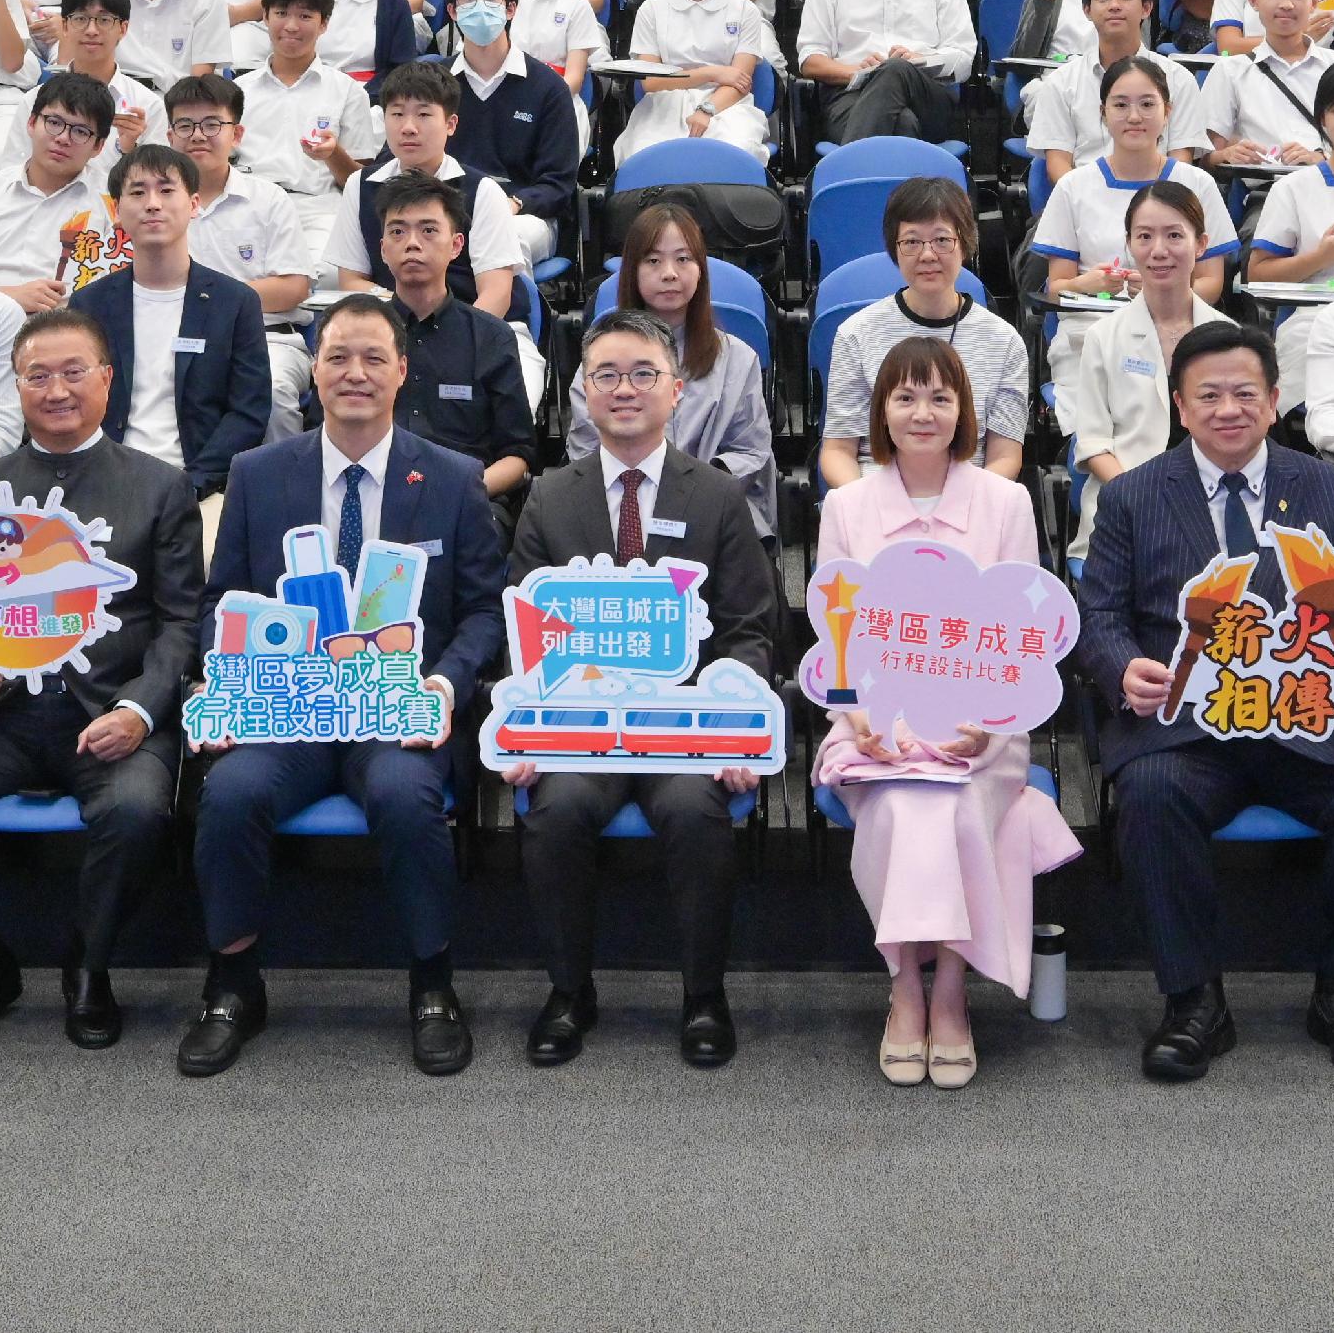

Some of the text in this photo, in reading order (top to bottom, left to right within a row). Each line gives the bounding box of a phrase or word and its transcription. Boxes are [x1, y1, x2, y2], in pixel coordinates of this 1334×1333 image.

[72, 228, 134, 263] 薪火
[541, 597, 680, 624] 大灣區城市
[541, 631, 672, 658] 列車出發！
[857, 606, 1047, 661] 灣區夢成真
[205, 650, 419, 696] 灣區夢成真
[880, 649, 1022, 687] 行程設計比賽
[184, 690, 442, 740] 行程設計比賽
